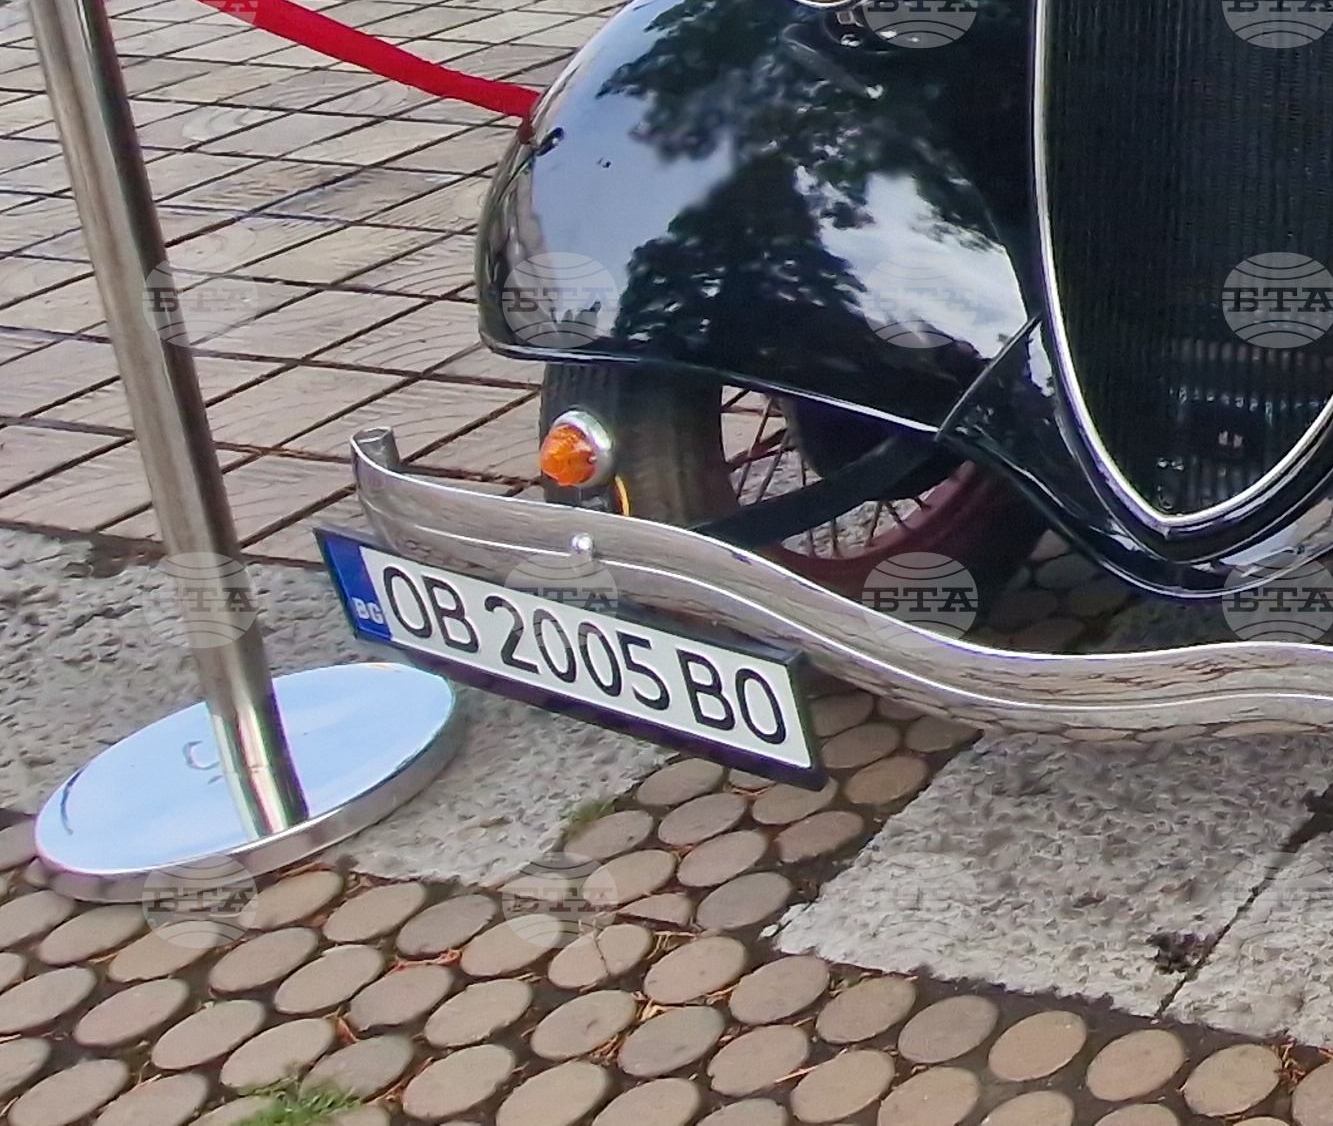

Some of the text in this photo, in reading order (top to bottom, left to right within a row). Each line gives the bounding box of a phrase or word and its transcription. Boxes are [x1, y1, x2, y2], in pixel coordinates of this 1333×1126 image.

[351, 596, 384, 625] BG
[382, 565, 788, 746] OB 2005 BO
